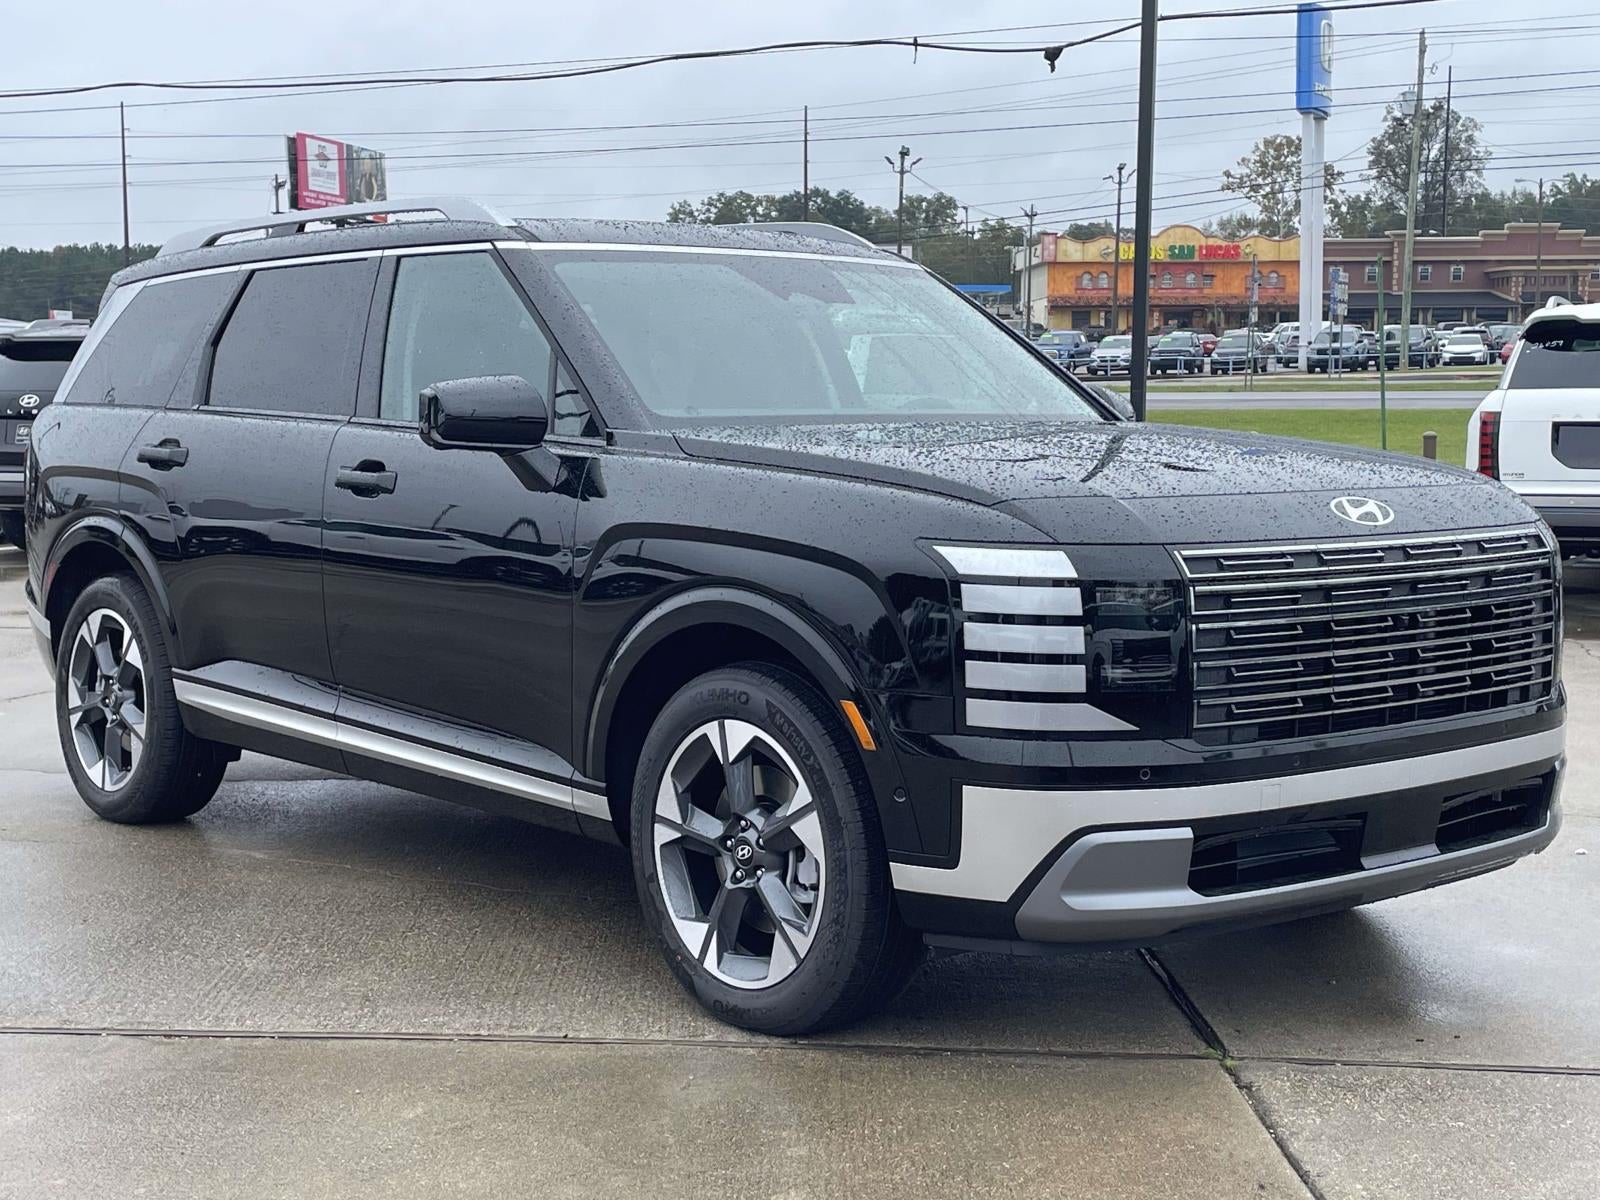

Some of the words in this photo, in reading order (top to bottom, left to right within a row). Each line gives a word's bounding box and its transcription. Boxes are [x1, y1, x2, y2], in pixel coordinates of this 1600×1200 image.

[1119, 244, 1164, 260] CAS
[1168, 244, 1196, 260] SAN
[1198, 243, 1241, 261] LUCAS
